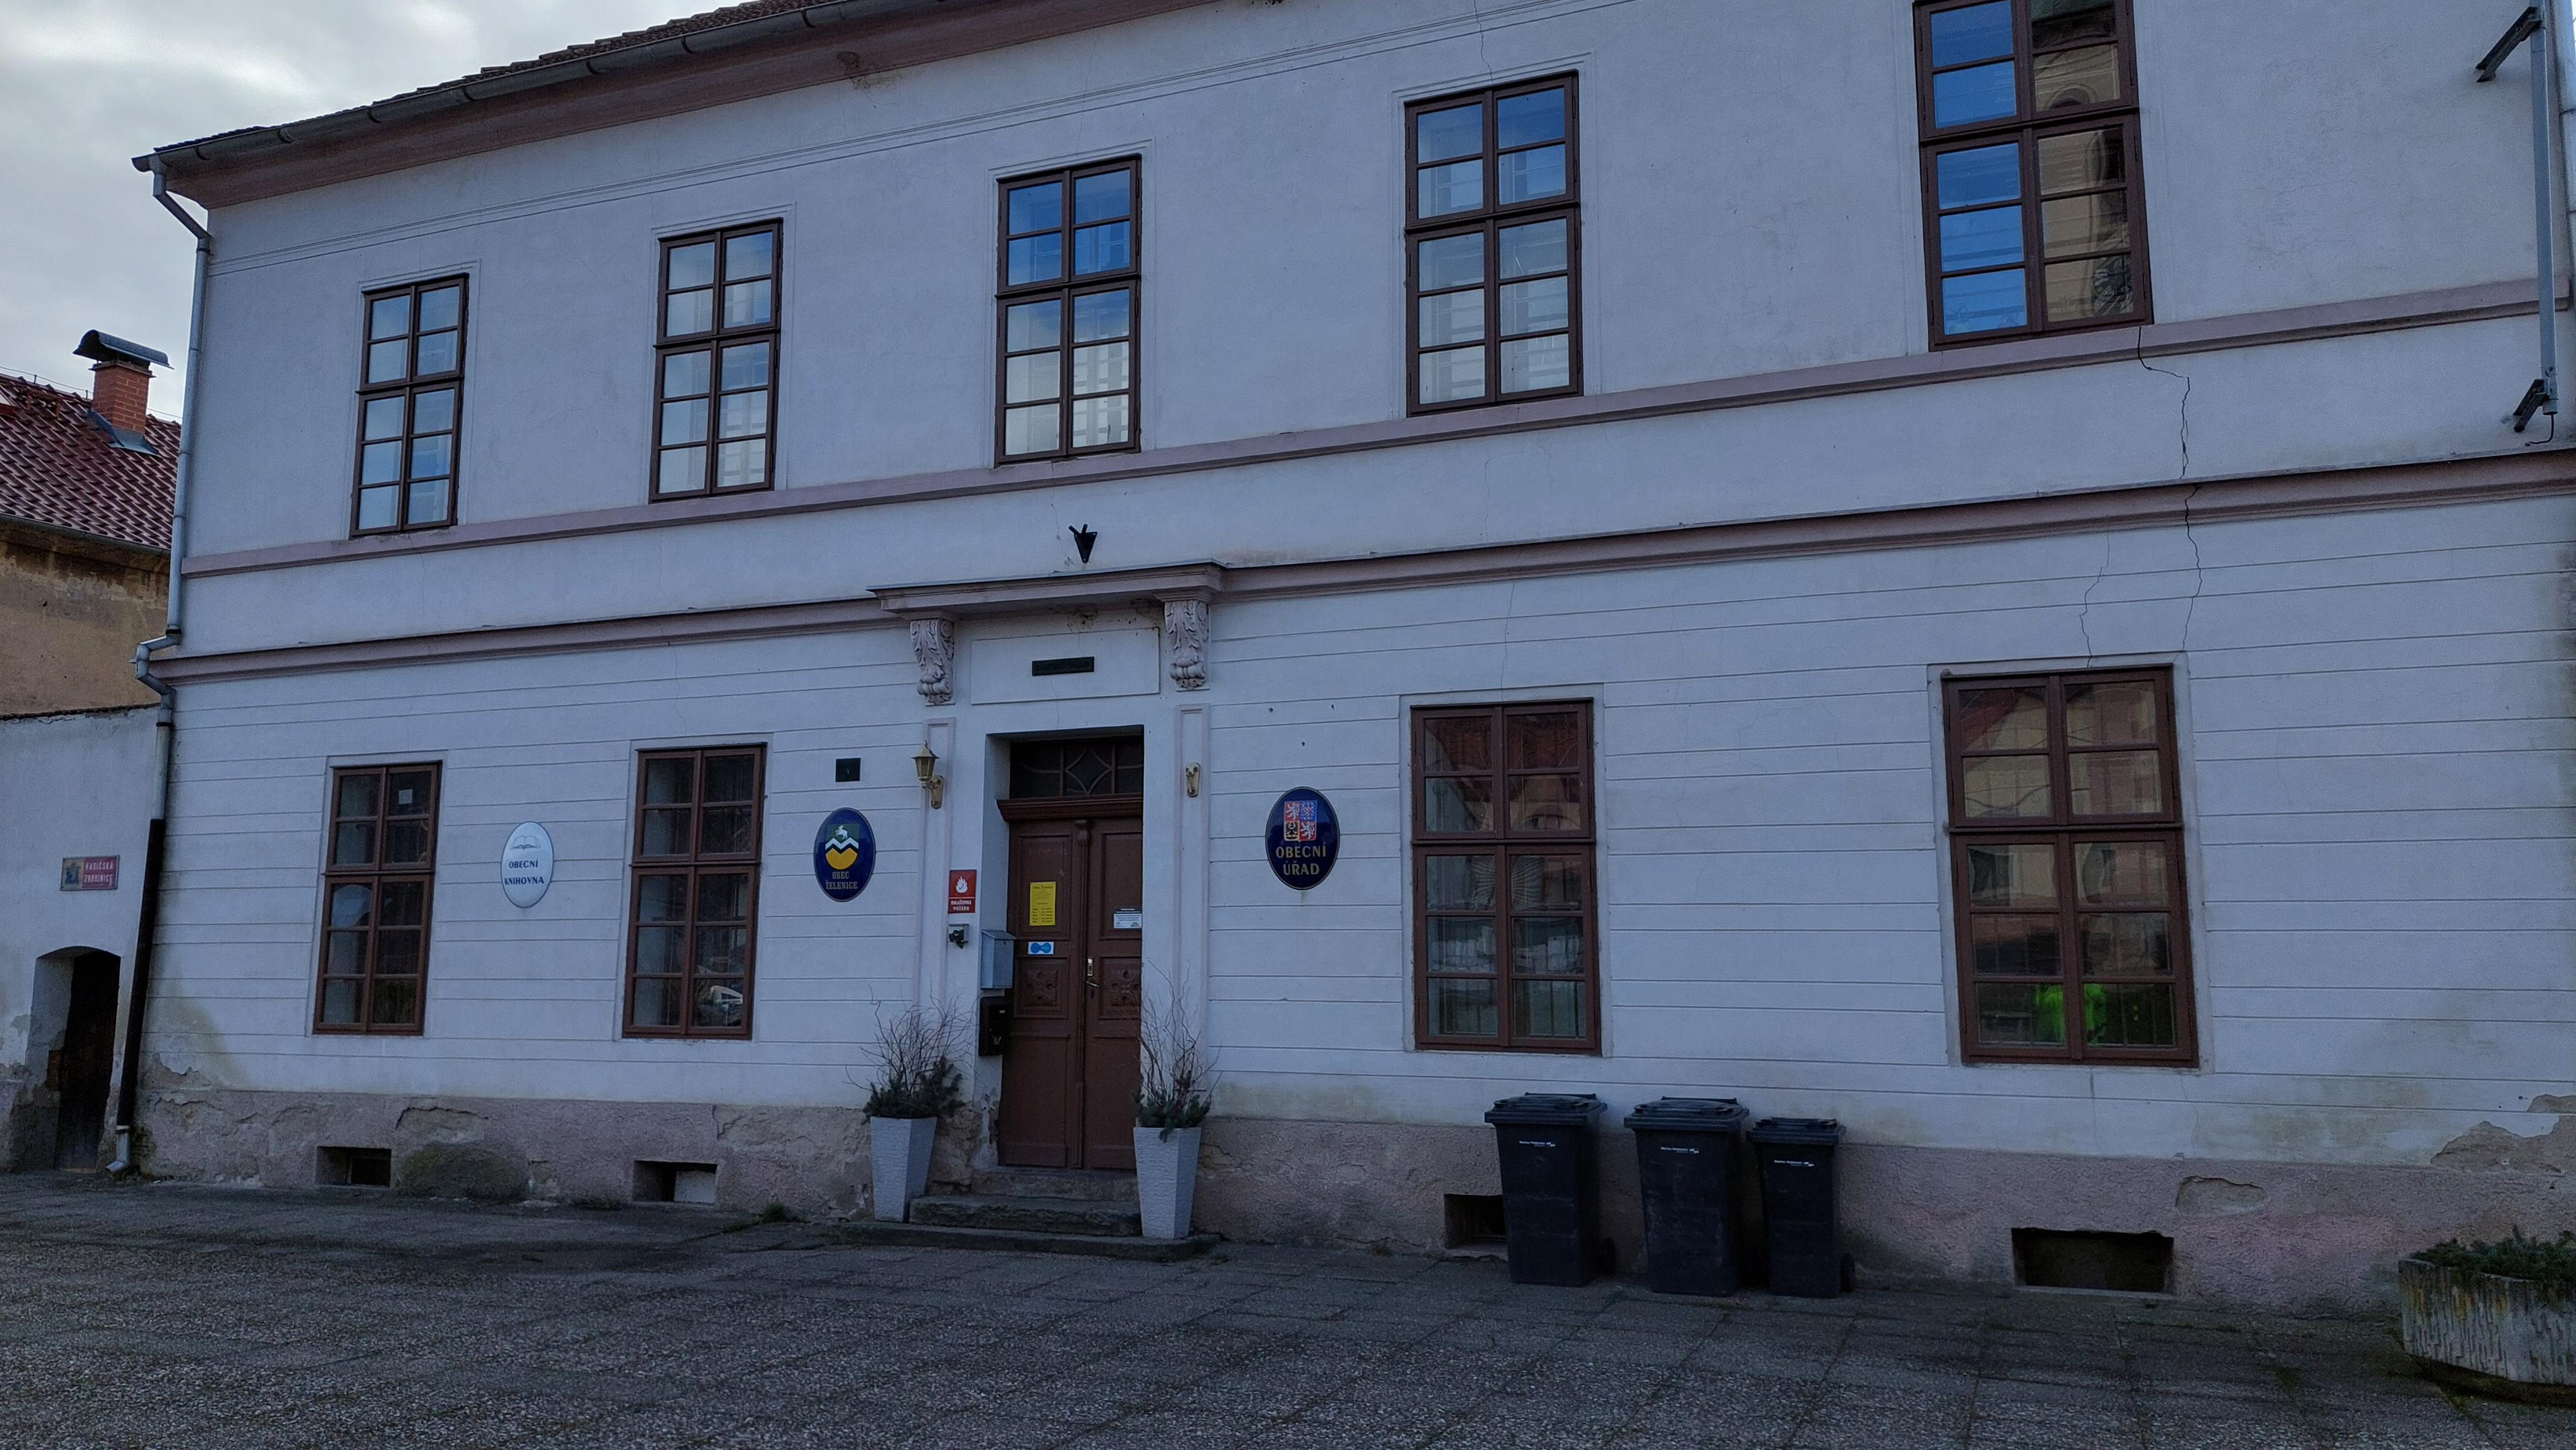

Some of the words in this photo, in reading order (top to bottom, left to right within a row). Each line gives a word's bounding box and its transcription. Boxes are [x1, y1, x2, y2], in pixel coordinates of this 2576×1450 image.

[1276, 842, 1327, 858] OBECNÍ
[85, 860, 113, 871] HASIČSKÁ
[509, 858, 538, 869] OBECNÍ
[1283, 860, 1320, 876] ÚŘAD
[84, 874, 113, 884] ZBROJNICE
[504, 876, 545, 885] KNIHOVNA
[832, 871, 849, 880] OBEC
[825, 880, 858, 890] ŽELENICE
